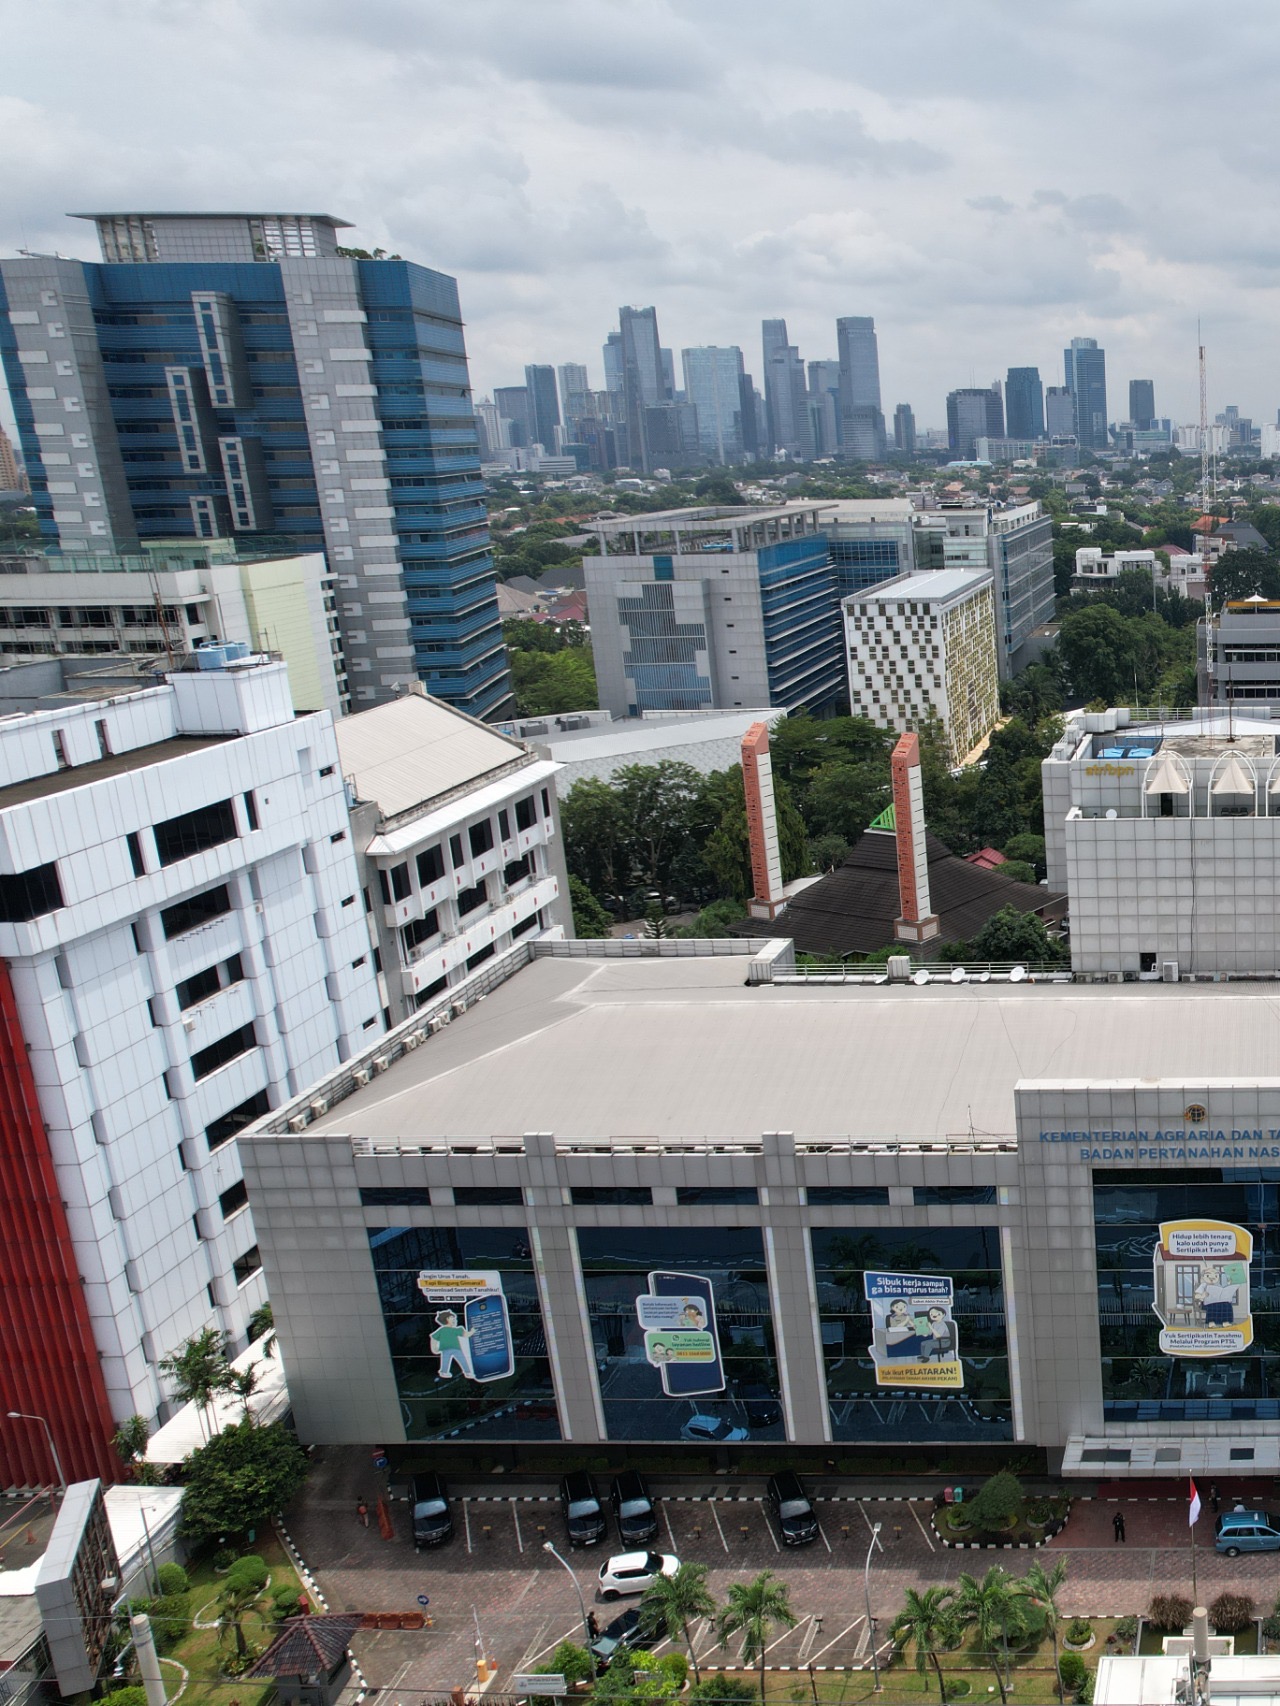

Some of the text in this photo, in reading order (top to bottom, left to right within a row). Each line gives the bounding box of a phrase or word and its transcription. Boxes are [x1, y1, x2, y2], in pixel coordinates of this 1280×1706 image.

[1040, 1130, 1148, 1143] KEMENTERIAN
[1155, 1130, 1226, 1142] AGRARIA
[1231, 1129, 1262, 1141] DAN
[1080, 1148, 1134, 1160] BADAN
[1139, 1147, 1244, 1159] PERTANAHAN
[877, 1277, 901, 1286] Sibuk
[903, 1278, 922, 1288] kerja
